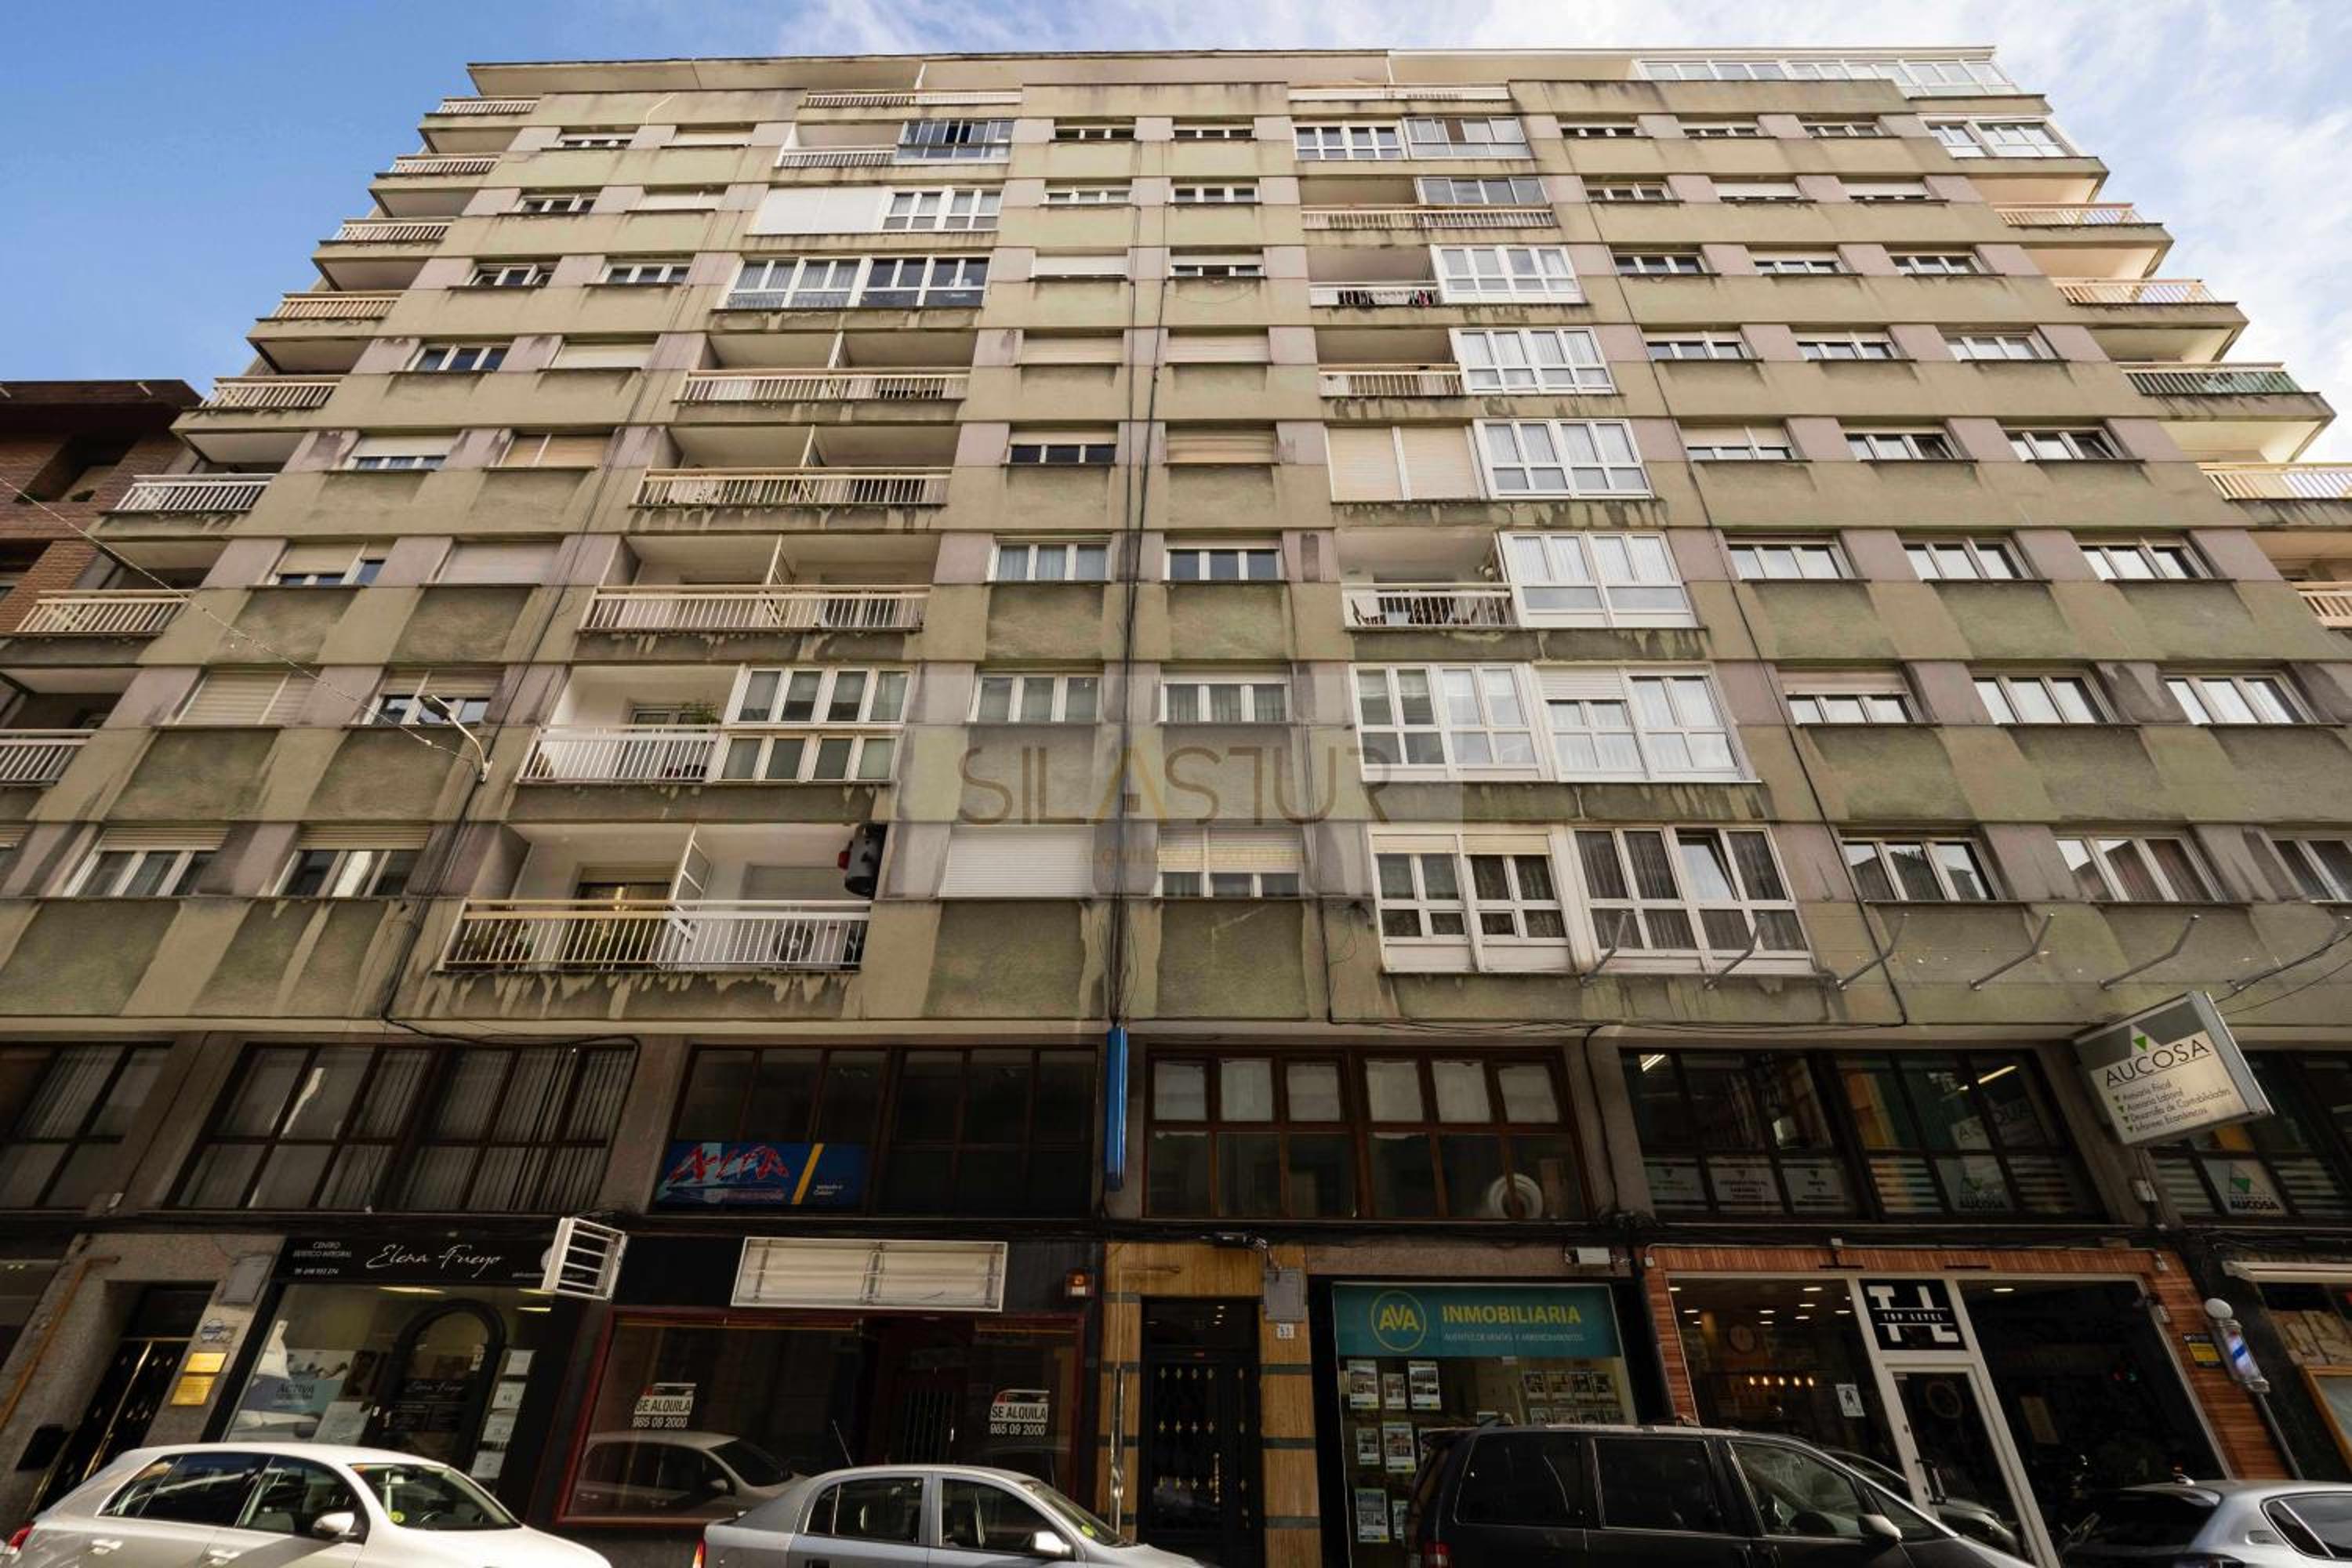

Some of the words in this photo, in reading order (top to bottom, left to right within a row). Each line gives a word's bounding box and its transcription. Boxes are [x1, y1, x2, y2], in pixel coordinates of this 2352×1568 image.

[2106, 1039, 2210, 1087] AUCOSA
[2157, 1087, 2183, 1102] Laboral
[2230, 1199, 2281, 1210] AUCOSA
[313, 1241, 341, 1250] CENTRO
[366, 1244, 432, 1269] Elena
[438, 1244, 503, 1279] Fueyo
[1378, 1304, 1420, 1330] AVA
[1443, 1305, 1582, 1325] INMOBILIARIA
[1882, 1312, 1904, 1321] TOP
[1910, 1312, 1944, 1322] LEVEL
[636, 1399, 650, 1412] SE
[651, 1399, 691, 1413] ALQUILA
[992, 1406, 1004, 1418] SE
[1007, 1406, 1047, 1420] ALQUILA
[664, 1417, 688, 1429] 2000
[1009, 1423, 1022, 1435] 09
[1022, 1423, 1046, 1436] 2000
